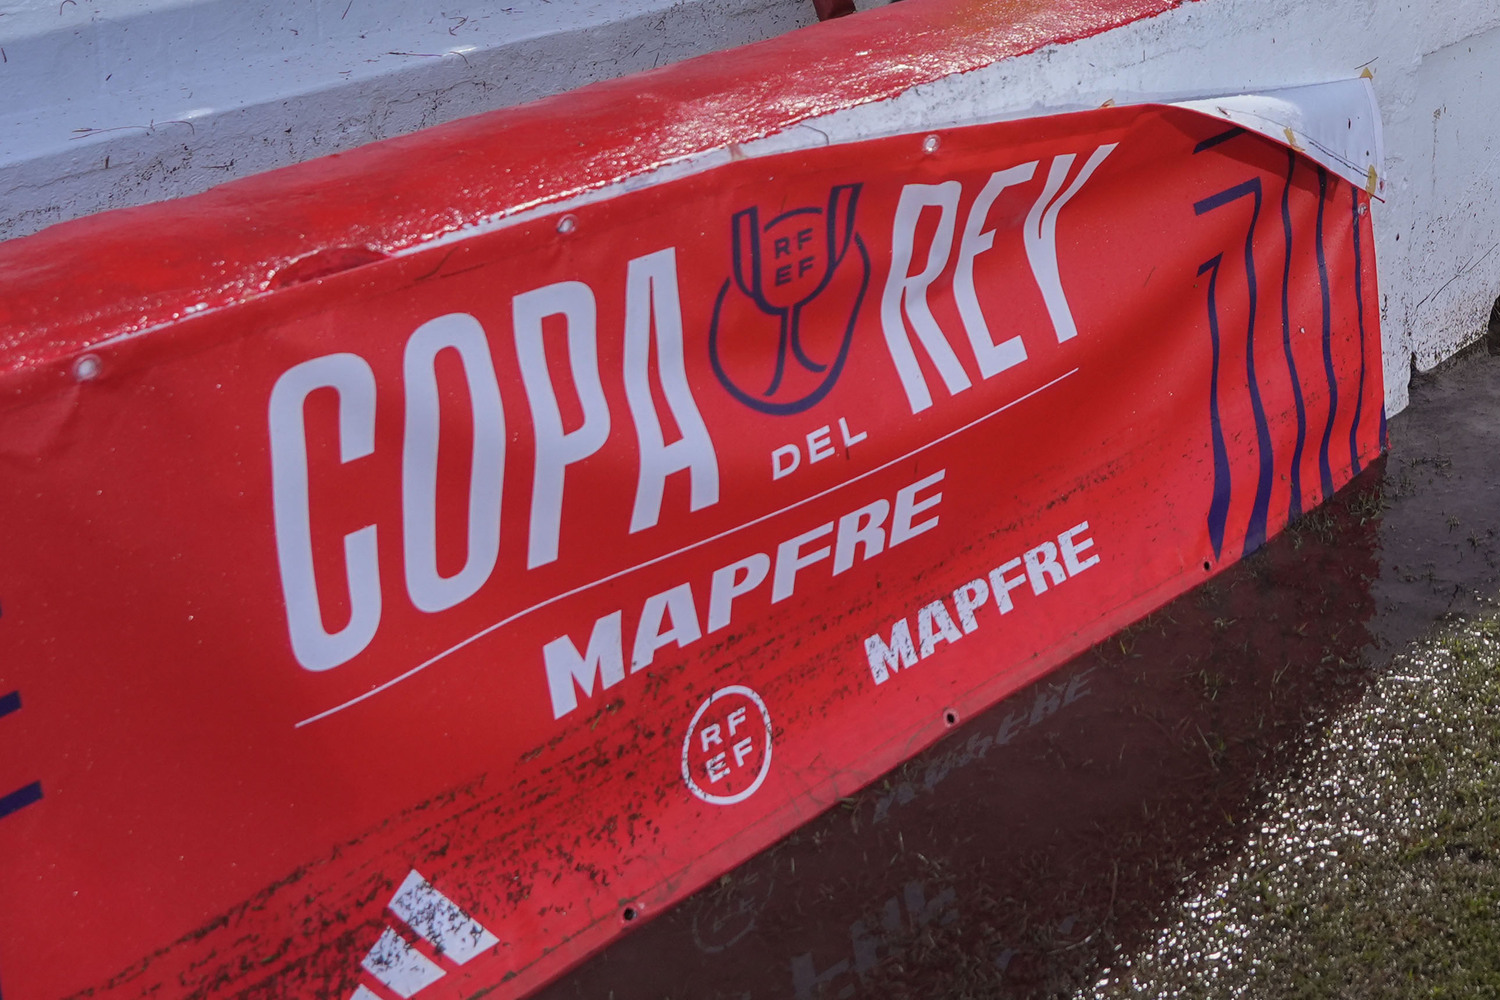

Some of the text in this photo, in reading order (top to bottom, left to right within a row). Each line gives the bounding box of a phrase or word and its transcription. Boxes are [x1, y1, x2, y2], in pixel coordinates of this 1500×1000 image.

[268, 143, 1120, 672] COPA DEL REY
[542, 469, 946, 720] MAPFRE
[863, 521, 1100, 686] MAPFRE
